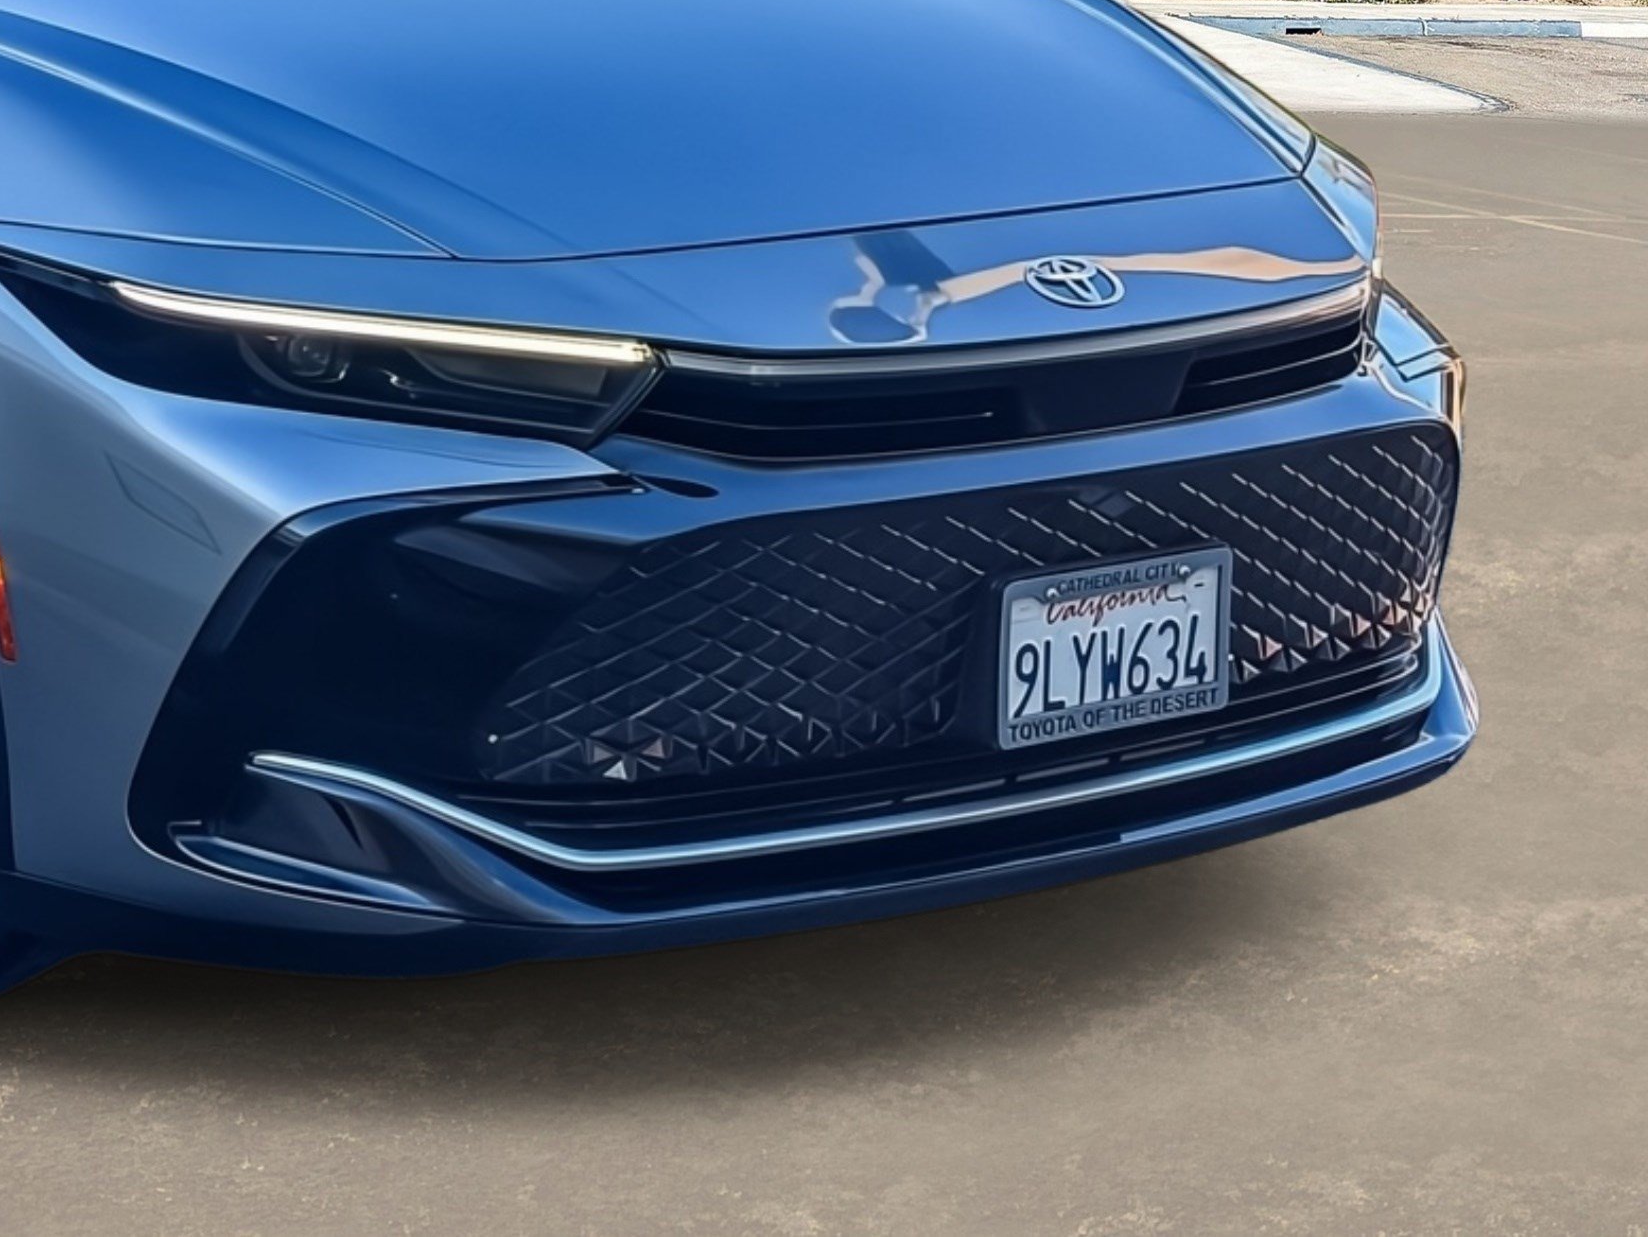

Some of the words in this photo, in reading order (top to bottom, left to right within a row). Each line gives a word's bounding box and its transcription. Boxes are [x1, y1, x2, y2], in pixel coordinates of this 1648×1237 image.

[1046, 583, 1187, 627] California
[1013, 613, 1208, 719] 9LYW634
[1008, 717, 1077, 743] TOYOTA
[1083, 708, 1106, 727] OF
[1112, 701, 1148, 721] THE
[1152, 688, 1219, 714] DESERT
